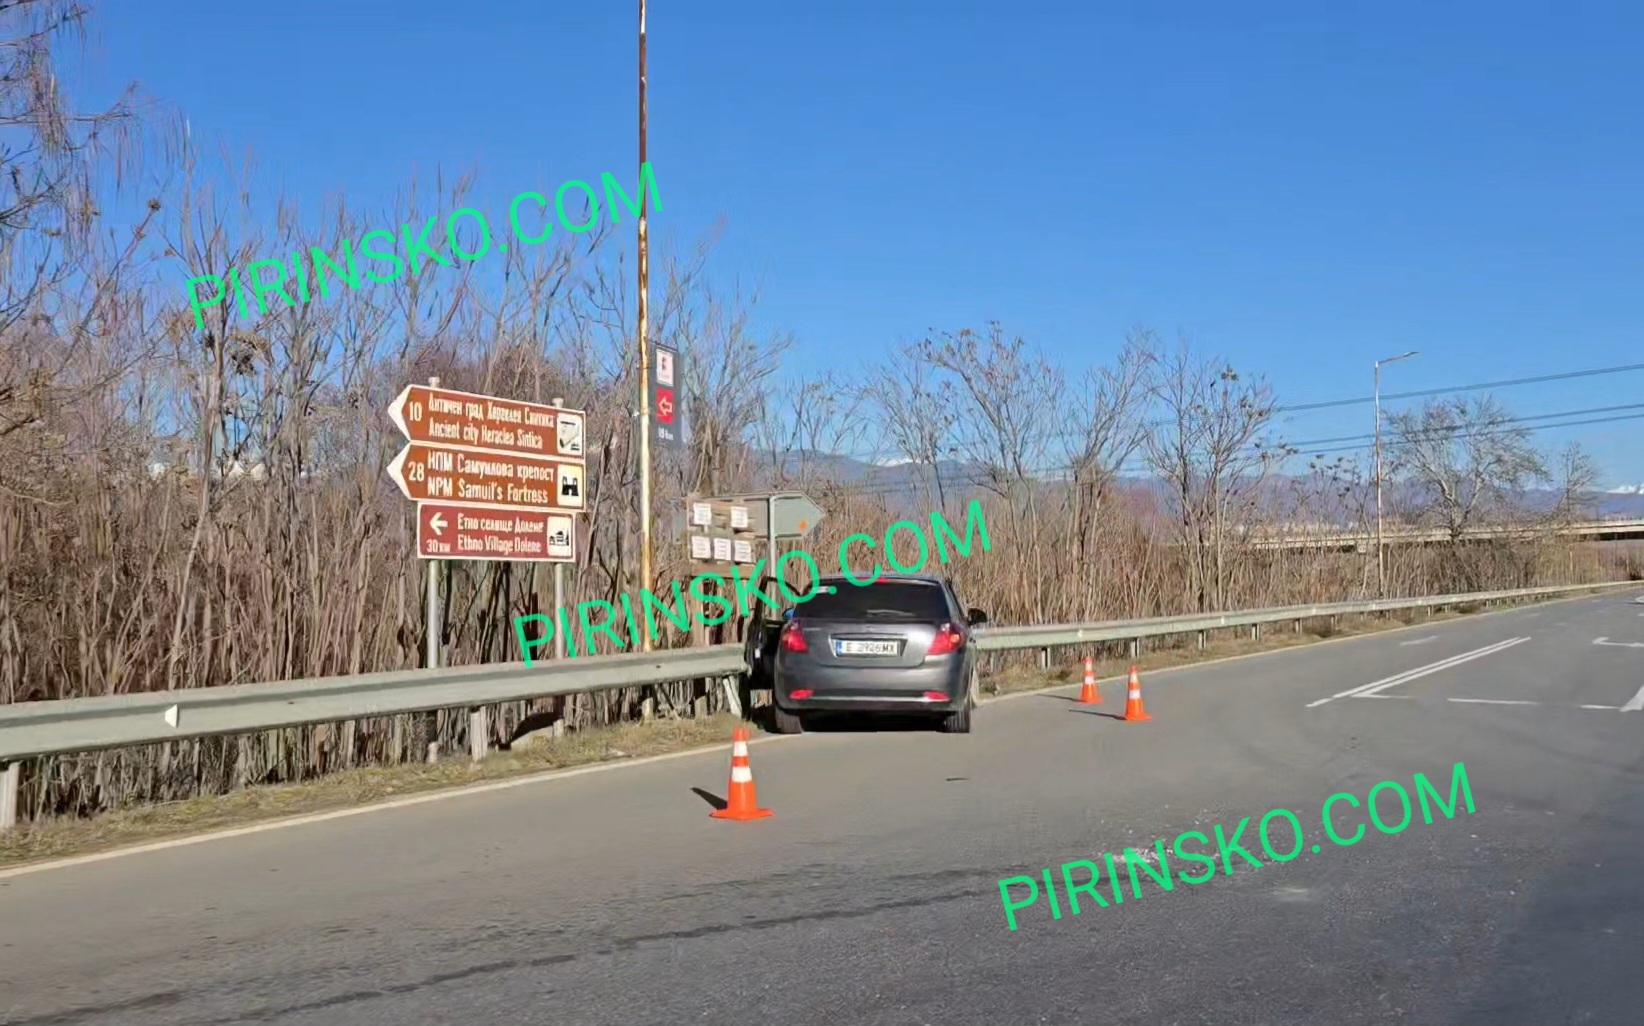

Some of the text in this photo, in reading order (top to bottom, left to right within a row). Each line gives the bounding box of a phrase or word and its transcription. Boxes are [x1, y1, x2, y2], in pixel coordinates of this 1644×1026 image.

[409, 401, 422, 422] 10
[465, 402, 484, 421] град
[428, 417, 543, 449] Ancient city Heraclea Sintica
[408, 461, 425, 482] 28
[427, 449, 554, 483] НПМ Самуилова крепост
[427, 476, 548, 504] NPM Samuil's Fortress
[426, 539, 438, 553] 30
[457, 534, 542, 555] Ethno Village Dolene
